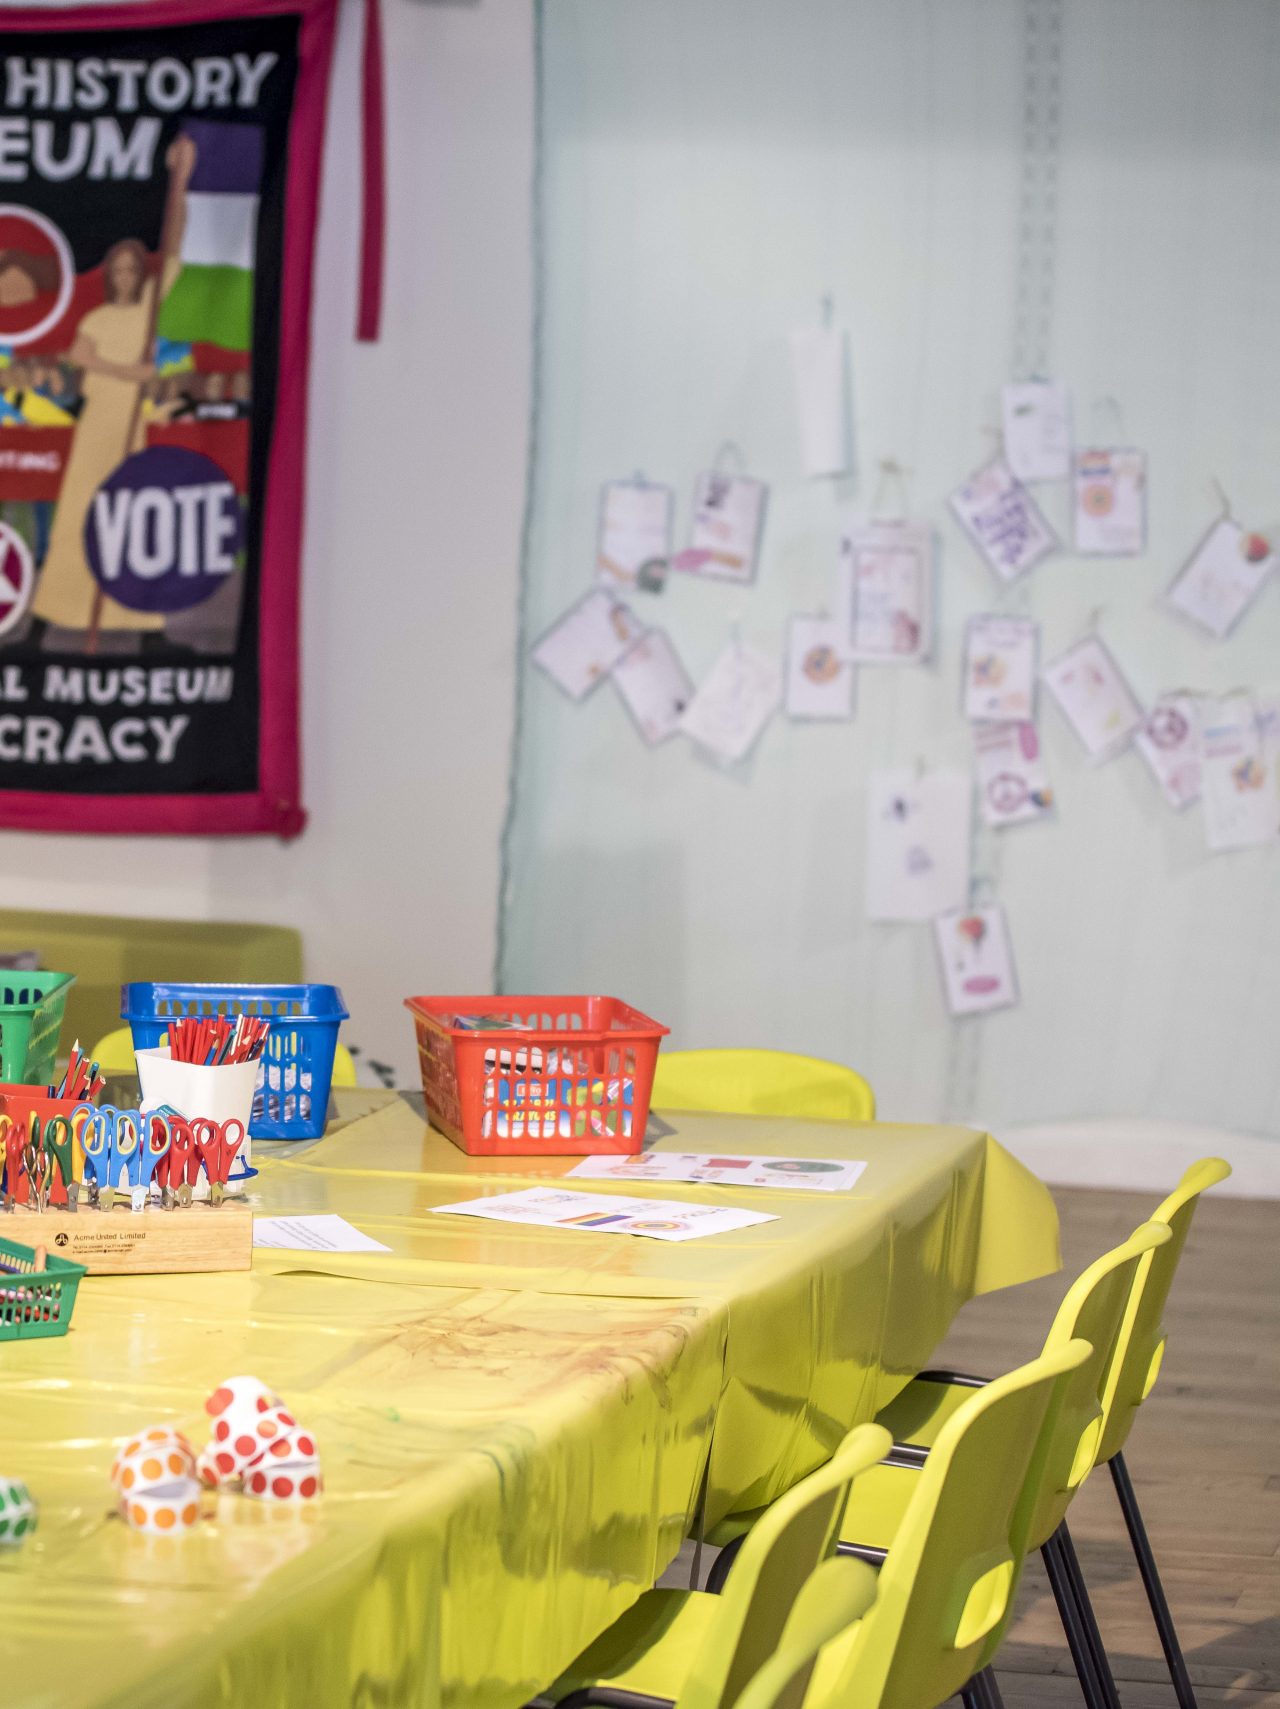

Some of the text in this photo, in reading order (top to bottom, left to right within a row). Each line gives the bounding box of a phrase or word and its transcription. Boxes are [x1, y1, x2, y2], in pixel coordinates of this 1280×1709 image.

[6, 52, 279, 112] HISTORY
[94, 481, 236, 581] VOTE
[42, 664, 234, 706] MUSEUM
[120, 1232, 146, 1240] Limited
